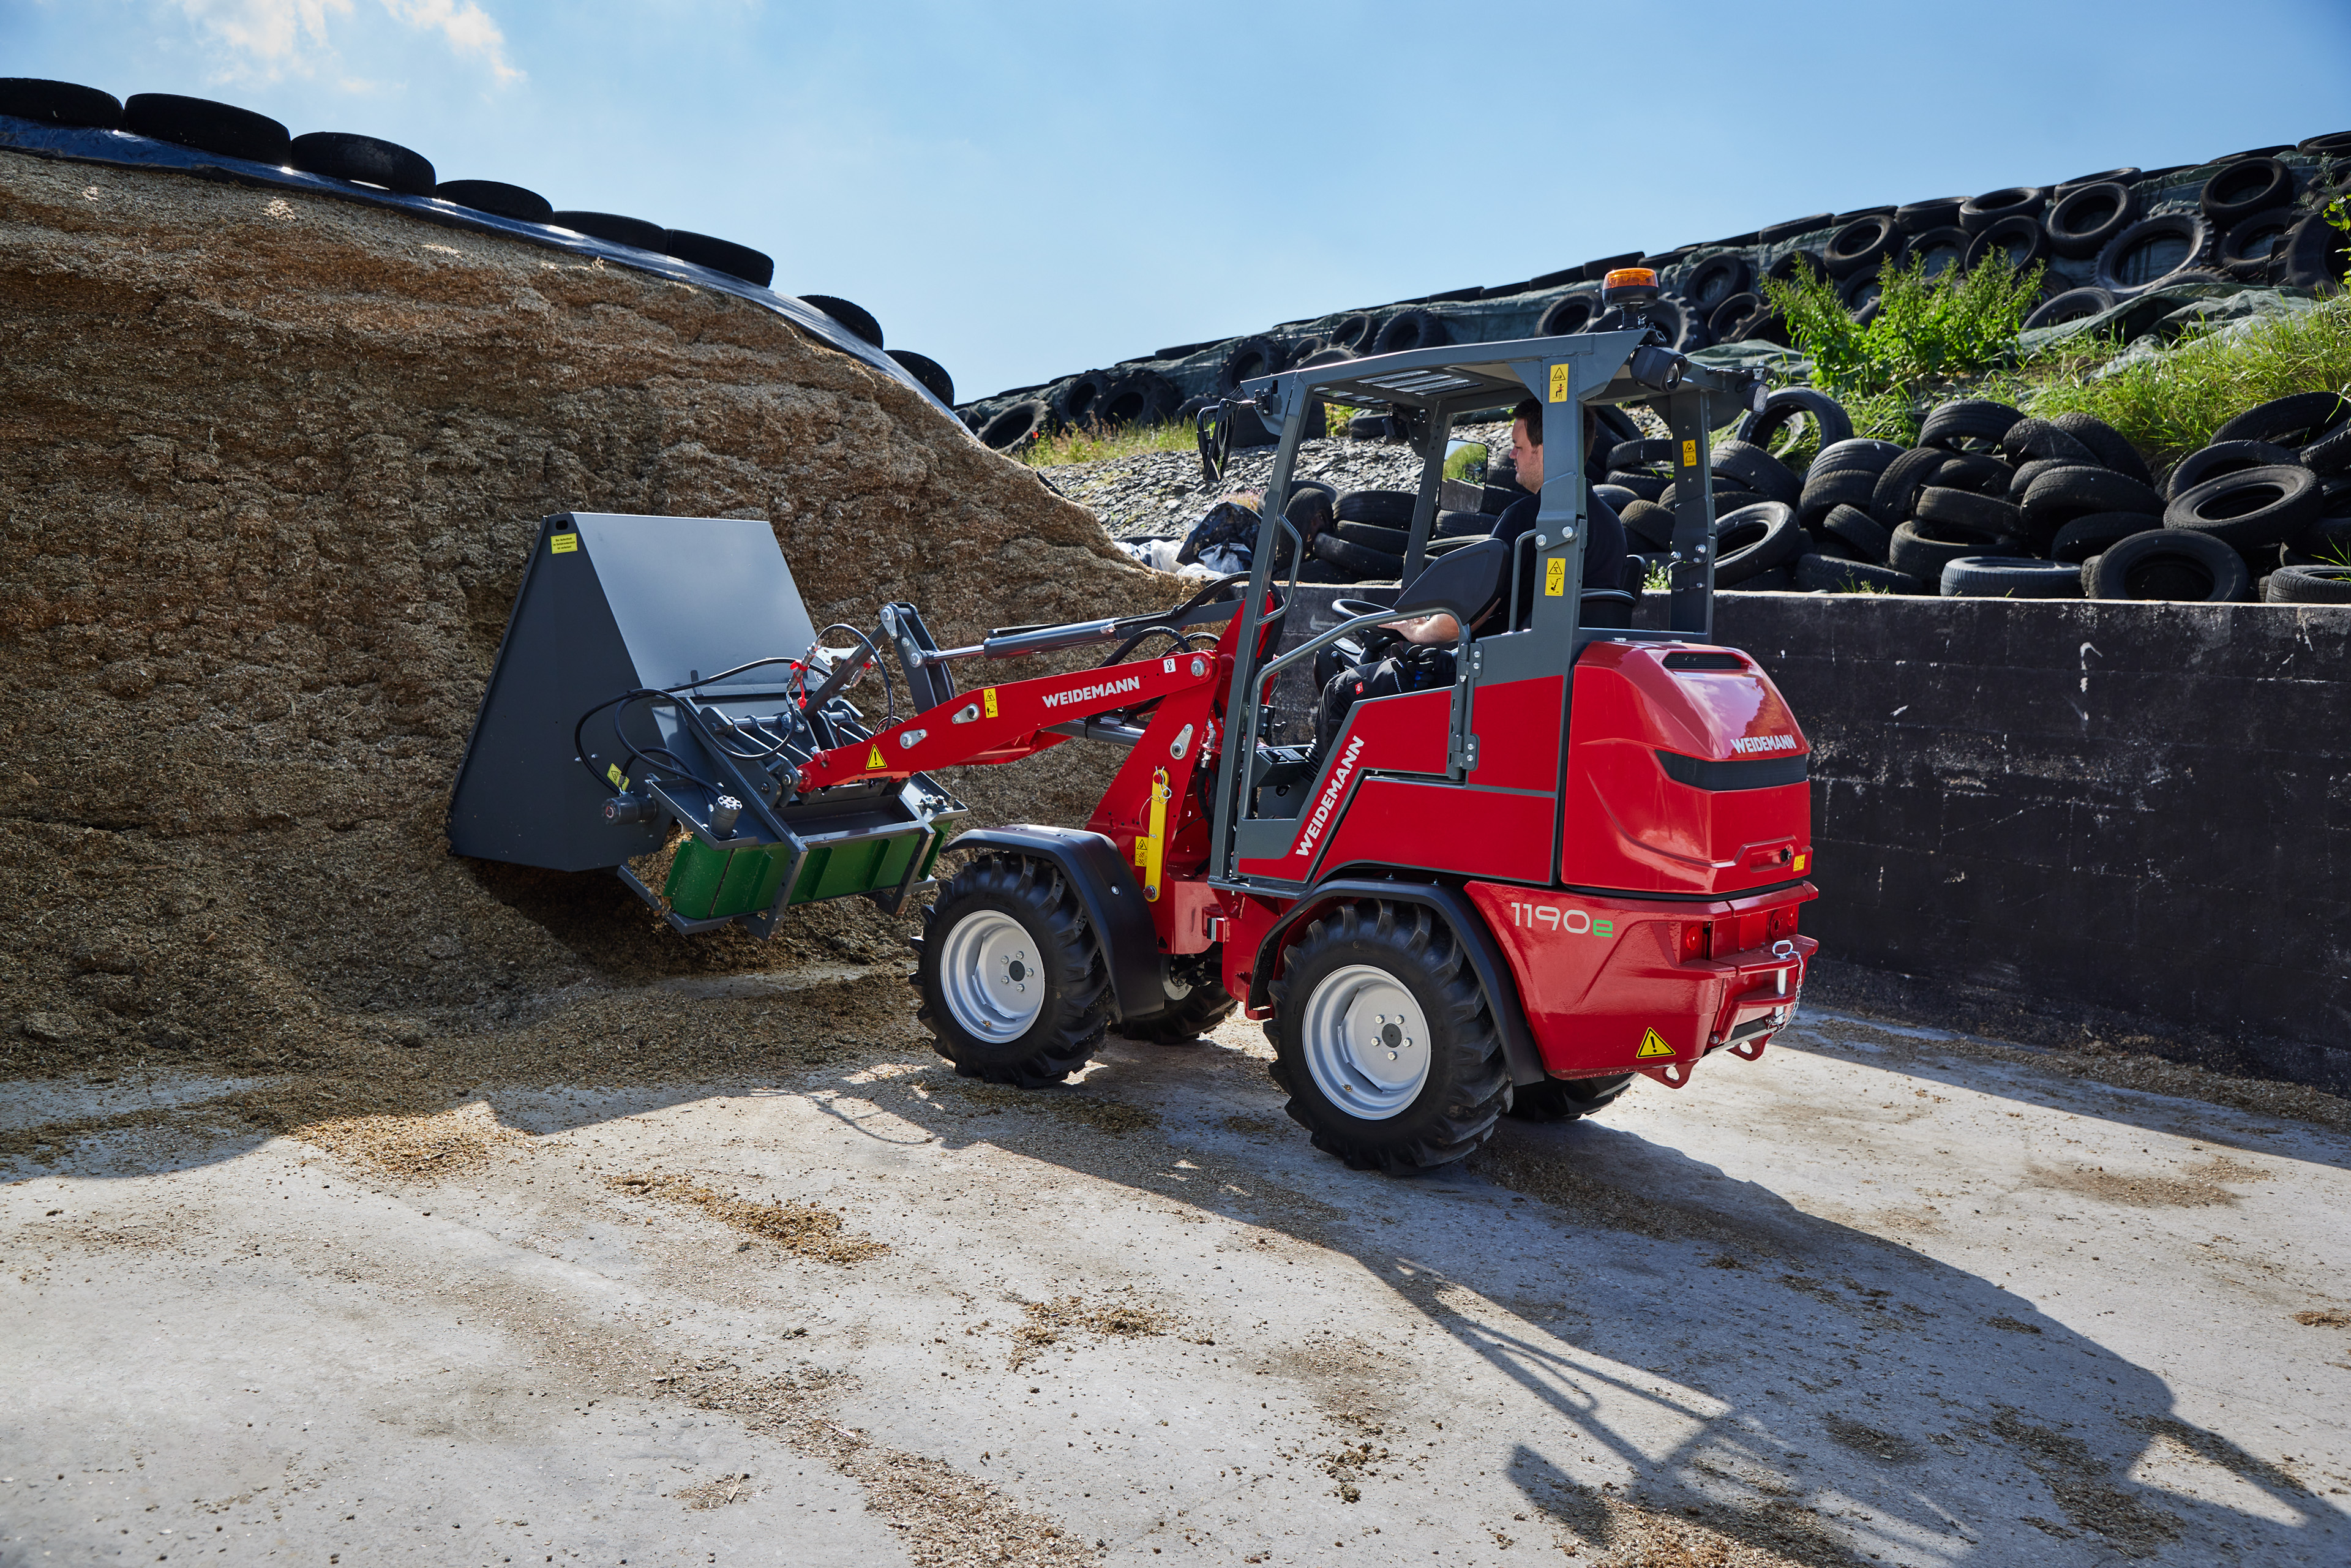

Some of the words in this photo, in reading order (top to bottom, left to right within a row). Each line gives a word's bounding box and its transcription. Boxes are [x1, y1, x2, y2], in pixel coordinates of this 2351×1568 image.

[1042, 676, 1140, 708] WEIDEMANN
[1730, 735, 1797, 754] WEIDEMANN
[1295, 735, 1365, 856] WEIDEMANN
[1511, 902, 1613, 938] 1190e
